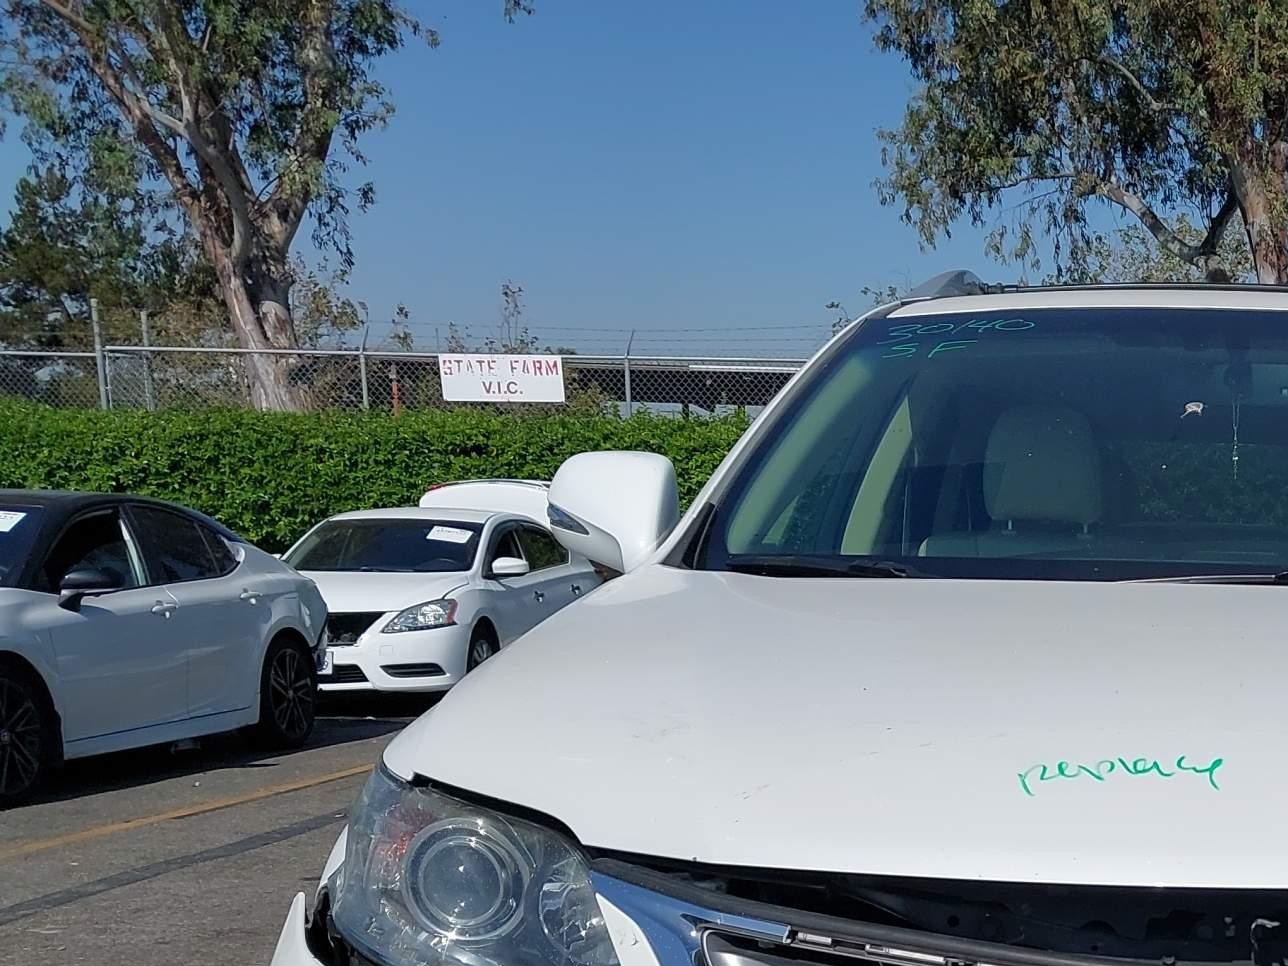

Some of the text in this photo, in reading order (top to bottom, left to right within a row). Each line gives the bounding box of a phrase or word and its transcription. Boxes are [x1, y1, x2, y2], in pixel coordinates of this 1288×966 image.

[443, 359, 559, 376] STATE FARM
[481, 381, 524, 395] V.I.C.
